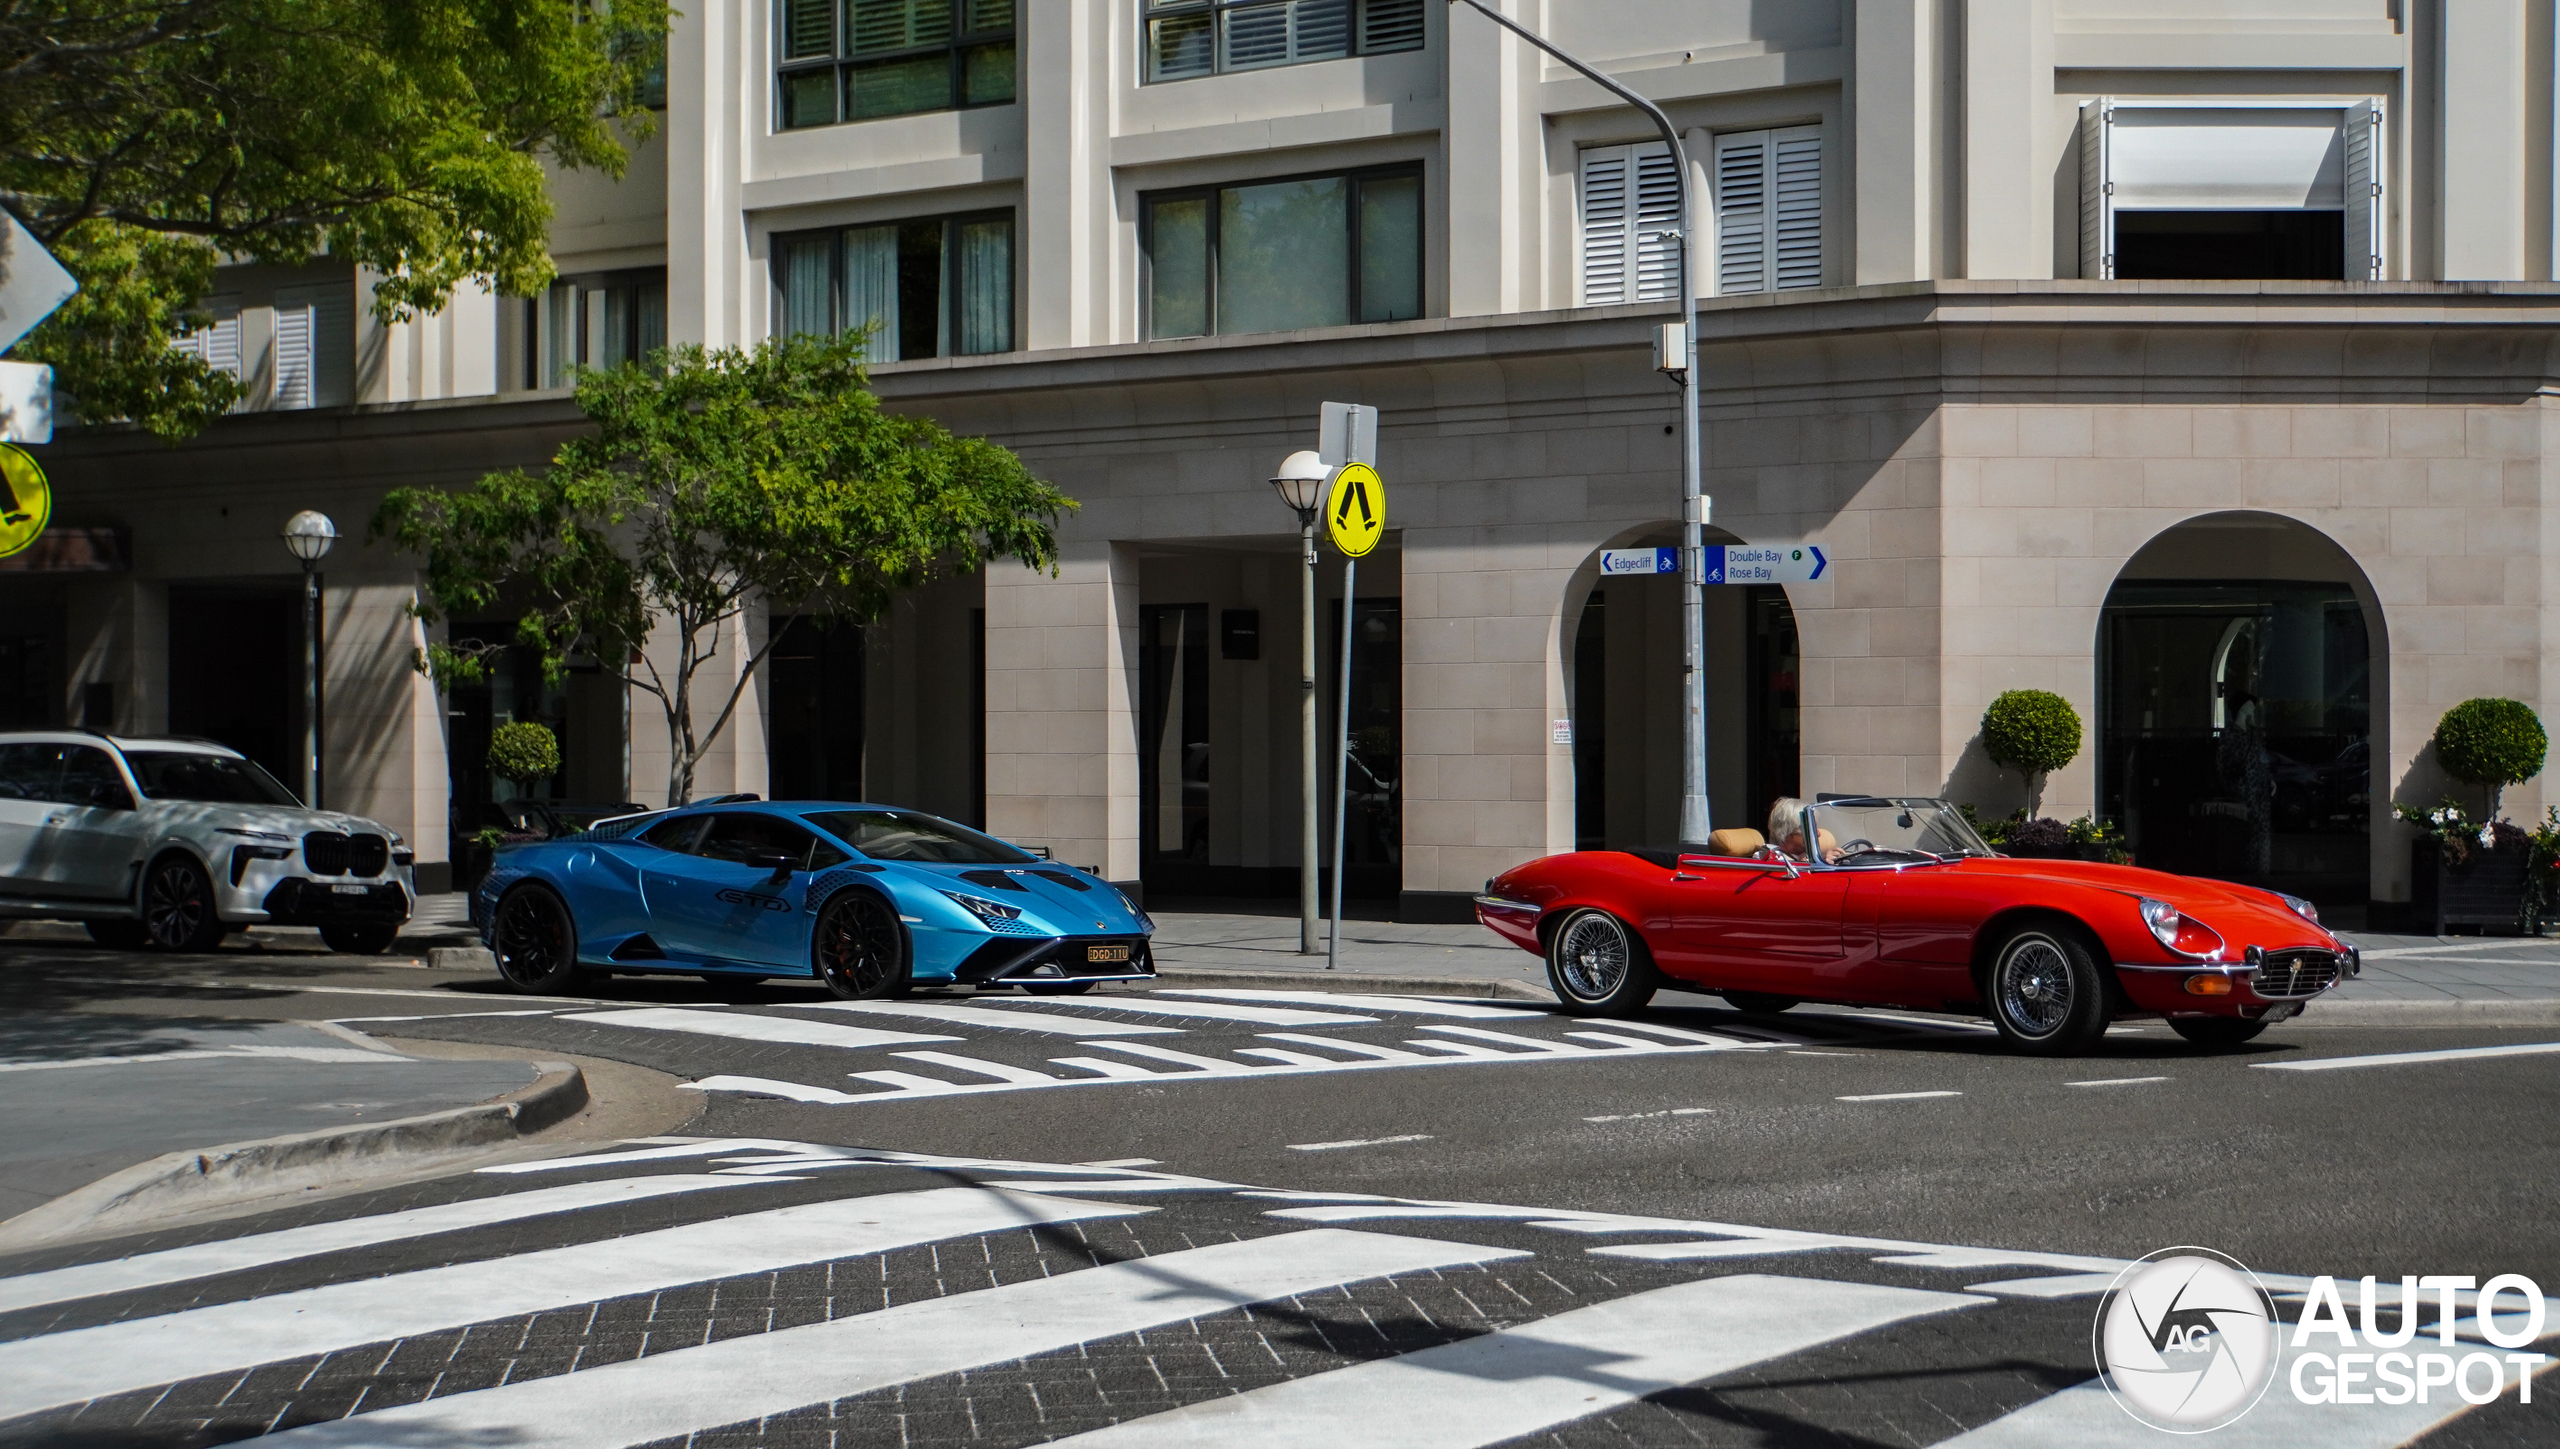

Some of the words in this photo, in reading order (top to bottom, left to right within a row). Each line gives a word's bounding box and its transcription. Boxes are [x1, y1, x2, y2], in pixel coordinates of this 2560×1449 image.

[1614, 556, 1652, 571] Edgecliff
[1729, 550, 1764, 562] Double
[1765, 550, 1783, 564] Bay
[1729, 567, 1753, 578] Rose
[1754, 567, 1772, 581] Bay
[724, 891, 783, 911] STO
